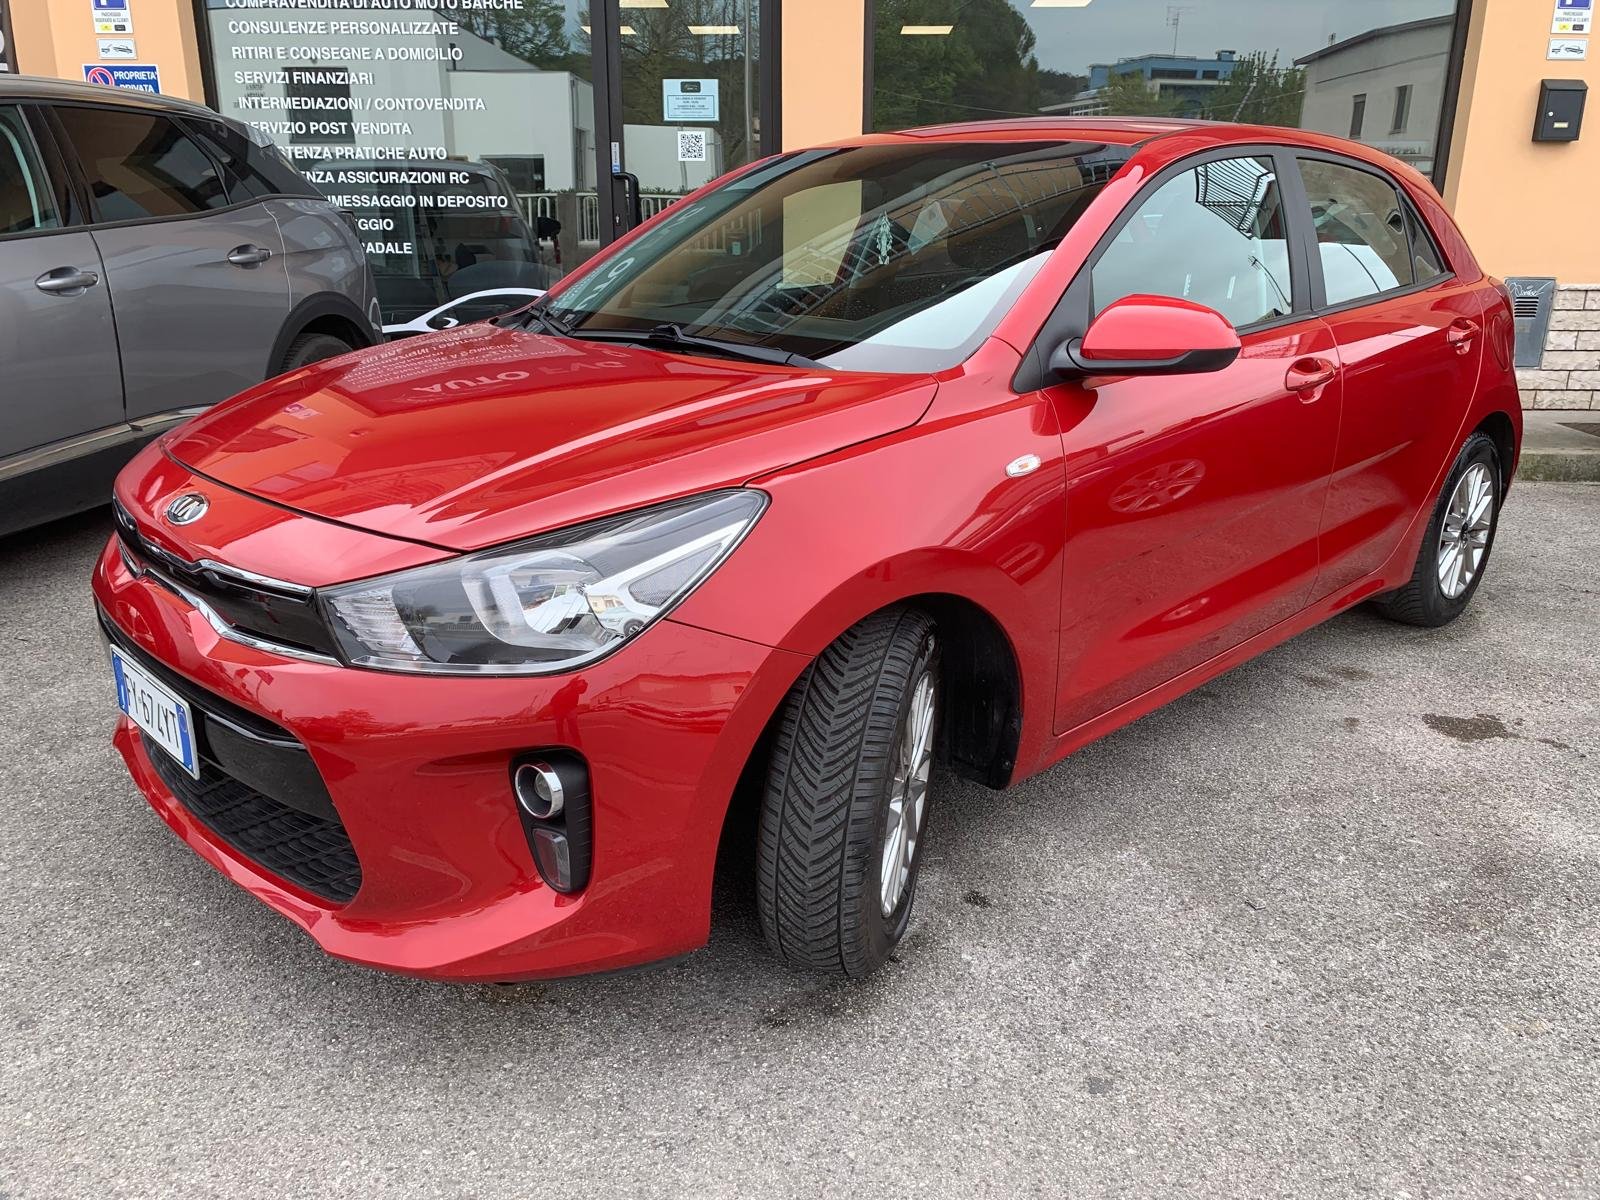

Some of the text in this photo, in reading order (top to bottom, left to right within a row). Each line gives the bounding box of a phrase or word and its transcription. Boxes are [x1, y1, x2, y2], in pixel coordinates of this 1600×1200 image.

[226, 0, 524, 9] COMPRAVENDITA DI AUTO MOTO BARCHE
[228, 21, 459, 35] CONSULENZE PERSONALIZZATE
[231, 46, 463, 61] RITIRI E CONSEGNE A DOMICILIO
[234, 71, 374, 85] SERVIZI FINANZIARI
[238, 96, 486, 111] INTERMEDIAZIONI / CONTOVENDITA
[244, 121, 413, 135] ERVIZIO POST VENDITA
[277, 146, 448, 160] TENZA PRATICHE AUTO
[300, 171, 470, 184] NZA ASSICURAZIONI RC
[327, 195, 508, 208] MESSAGGIO IN DEPOSITO
[355, 218, 394, 231] GGIO
[362, 242, 413, 254] ADALE
